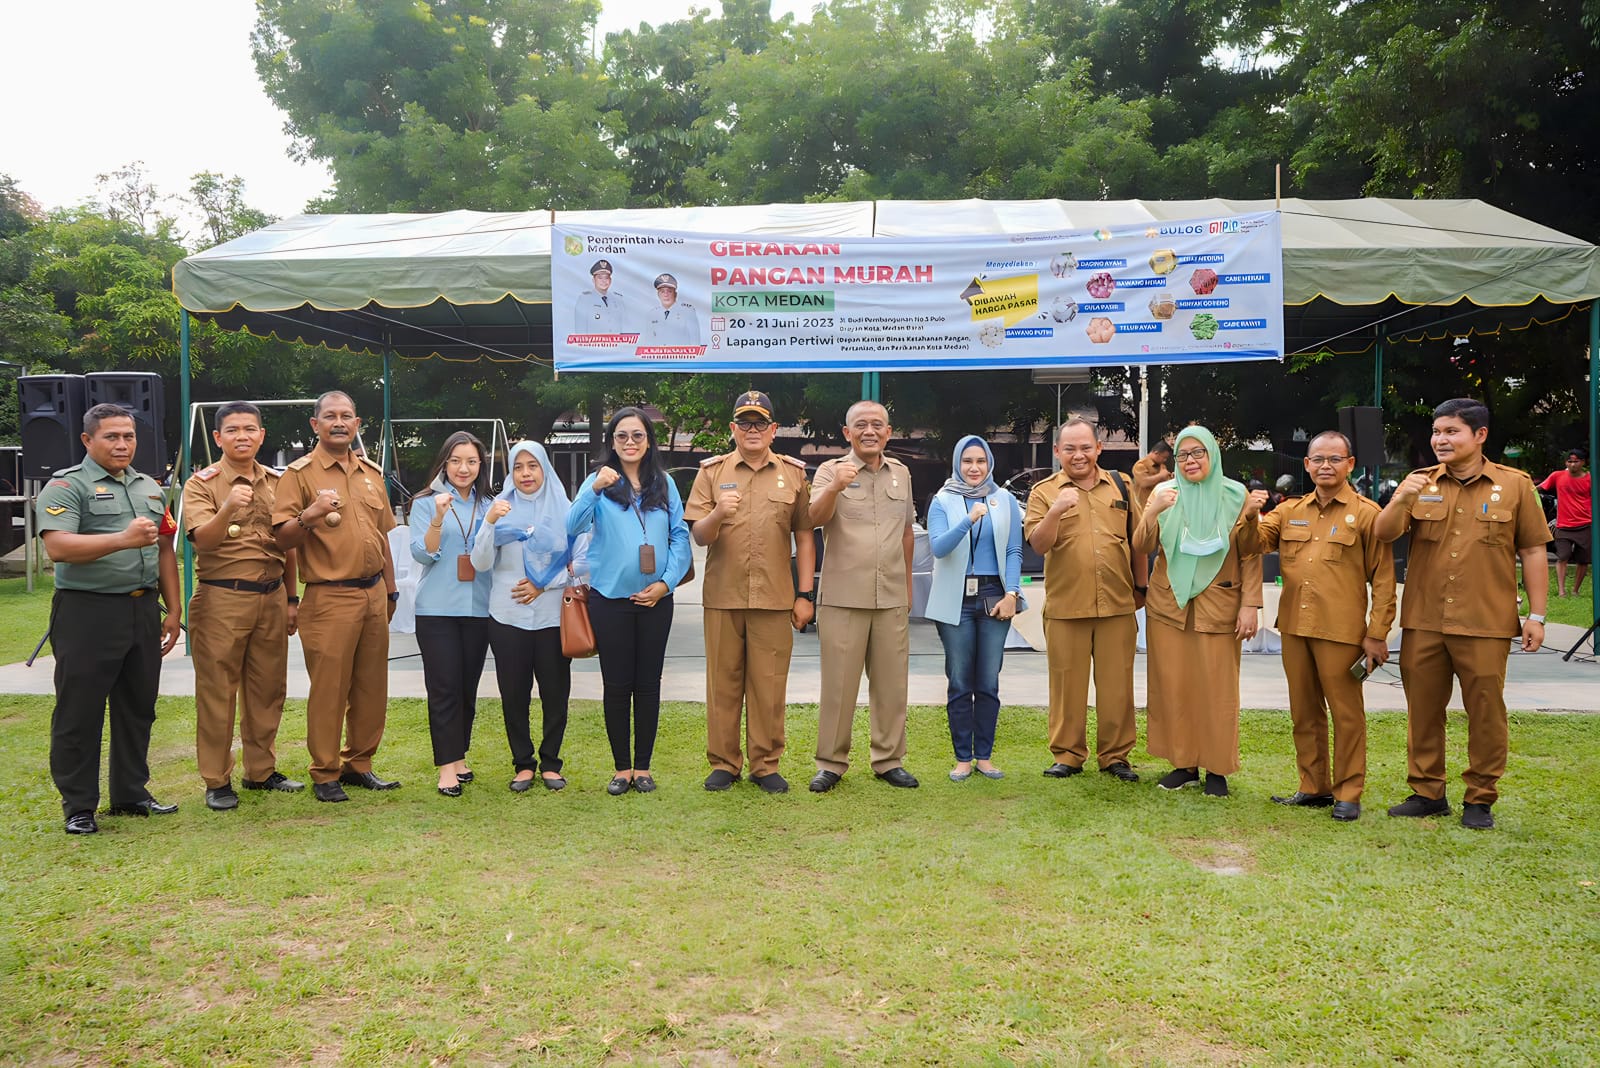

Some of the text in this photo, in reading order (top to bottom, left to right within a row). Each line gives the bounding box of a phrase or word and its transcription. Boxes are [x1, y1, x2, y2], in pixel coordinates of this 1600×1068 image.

[1160, 226, 1203, 235] BULOG
[587, 235, 685, 244] Pemerintah Kota
[588, 245, 626, 254] Medan
[709, 240, 841, 256] GERAKAN
[710, 264, 933, 286] PANGAN MURAH
[715, 294, 825, 307] KOTA MEDAN
[974, 292, 1017, 306] DIBAWAH
[975, 298, 1038, 316] HARGA PASAR
[729, 318, 746, 328] 20
[756, 318, 768, 328] 21
[771, 317, 799, 328] Juni
[802, 318, 834, 328] 2023
[726, 336, 834, 348] Lapangan Pertiwi
